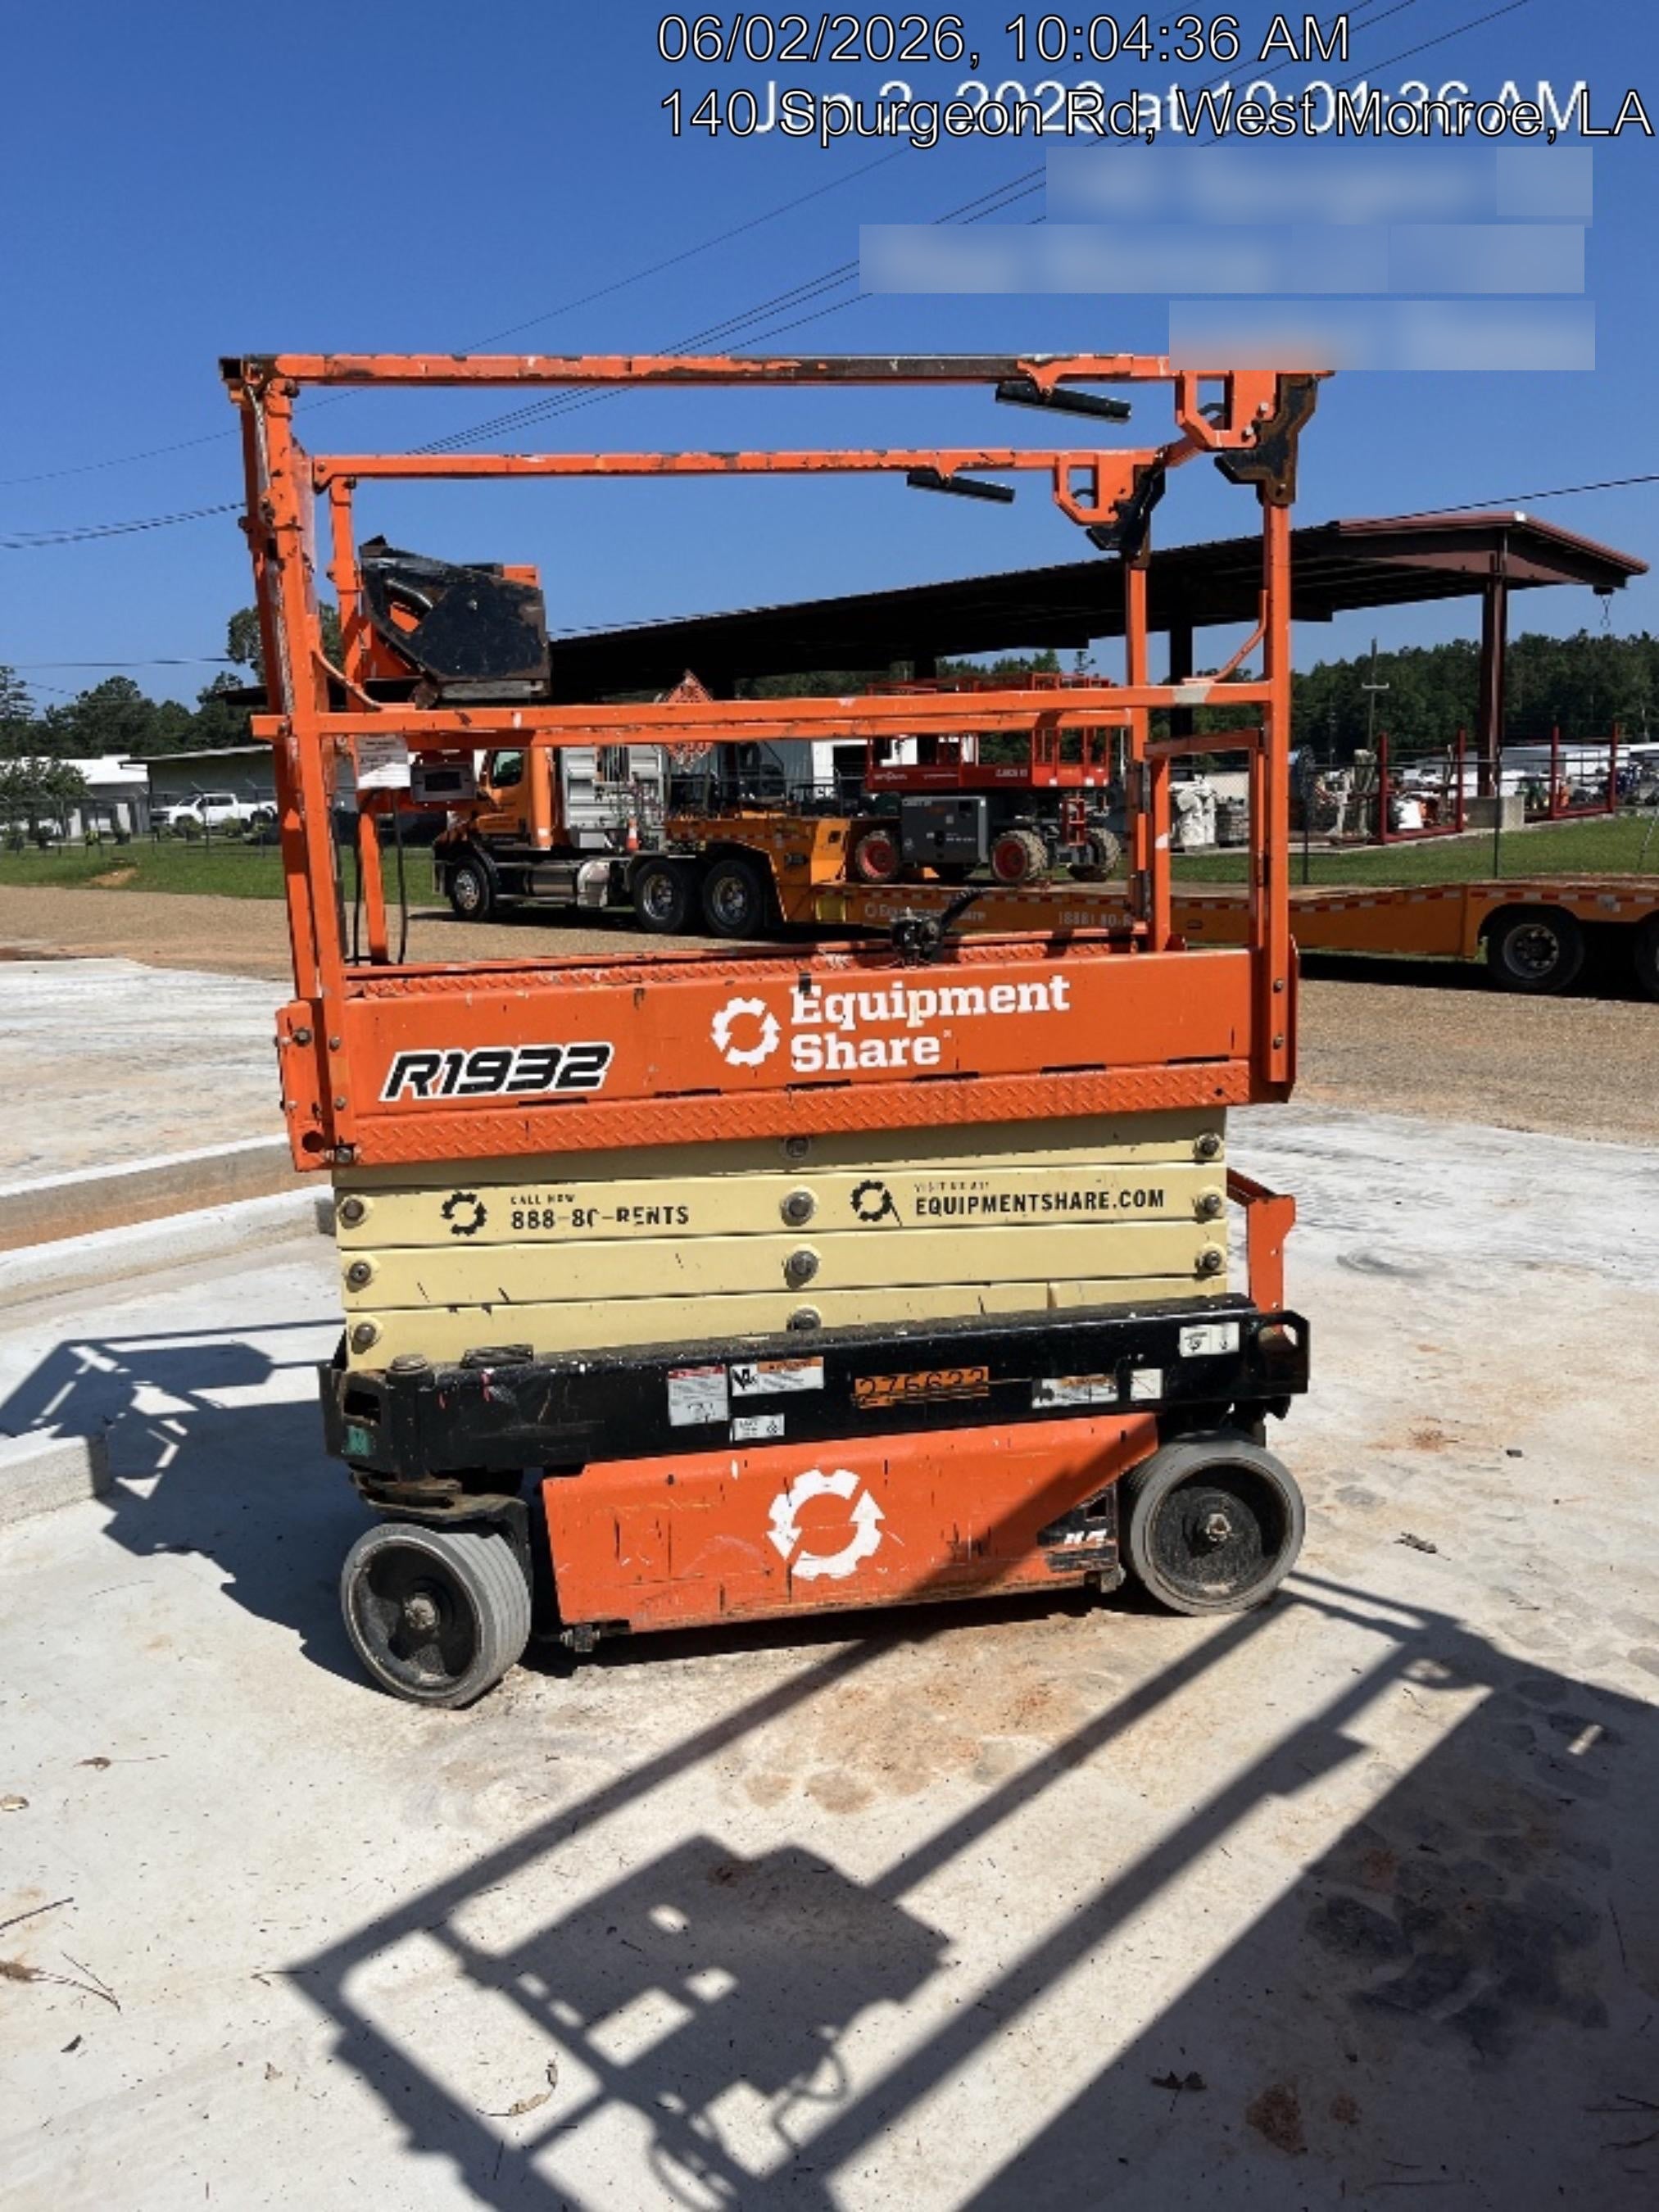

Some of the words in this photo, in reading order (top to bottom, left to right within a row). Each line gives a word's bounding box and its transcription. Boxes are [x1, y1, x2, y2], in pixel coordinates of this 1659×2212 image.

[789, 975, 1070, 1031] Equipment
[379, 1041, 614, 1101] R1932
[791, 1032, 941, 1072] Share
[915, 1190, 1164, 1216] EQUIPMENTSHARE.COM
